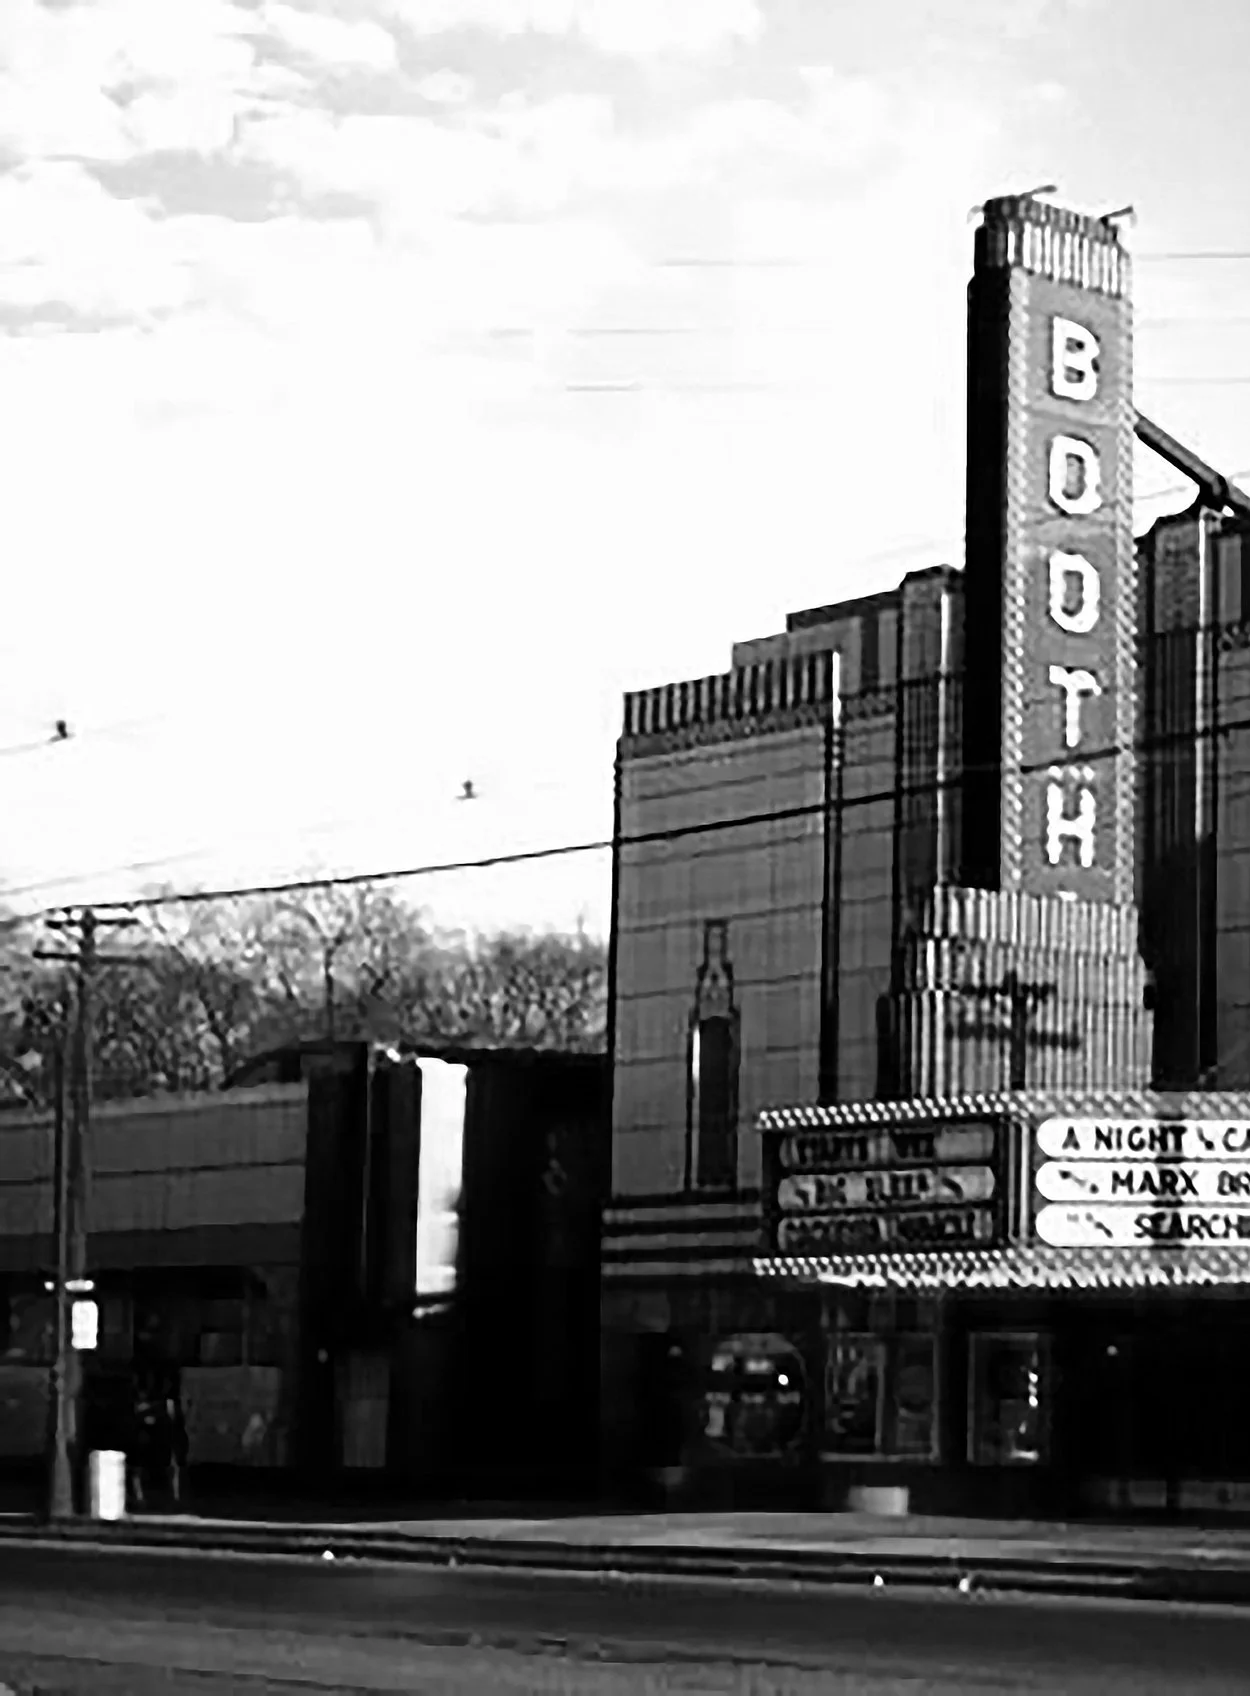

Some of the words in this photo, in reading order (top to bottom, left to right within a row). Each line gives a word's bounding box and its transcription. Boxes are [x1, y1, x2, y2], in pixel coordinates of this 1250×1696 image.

[1046, 315, 1102, 868] BOOTH
[1061, 1125, 1081, 1151] A
[1094, 1125, 1188, 1152] NIGHT
[1110, 1169, 1200, 1196] MARX
